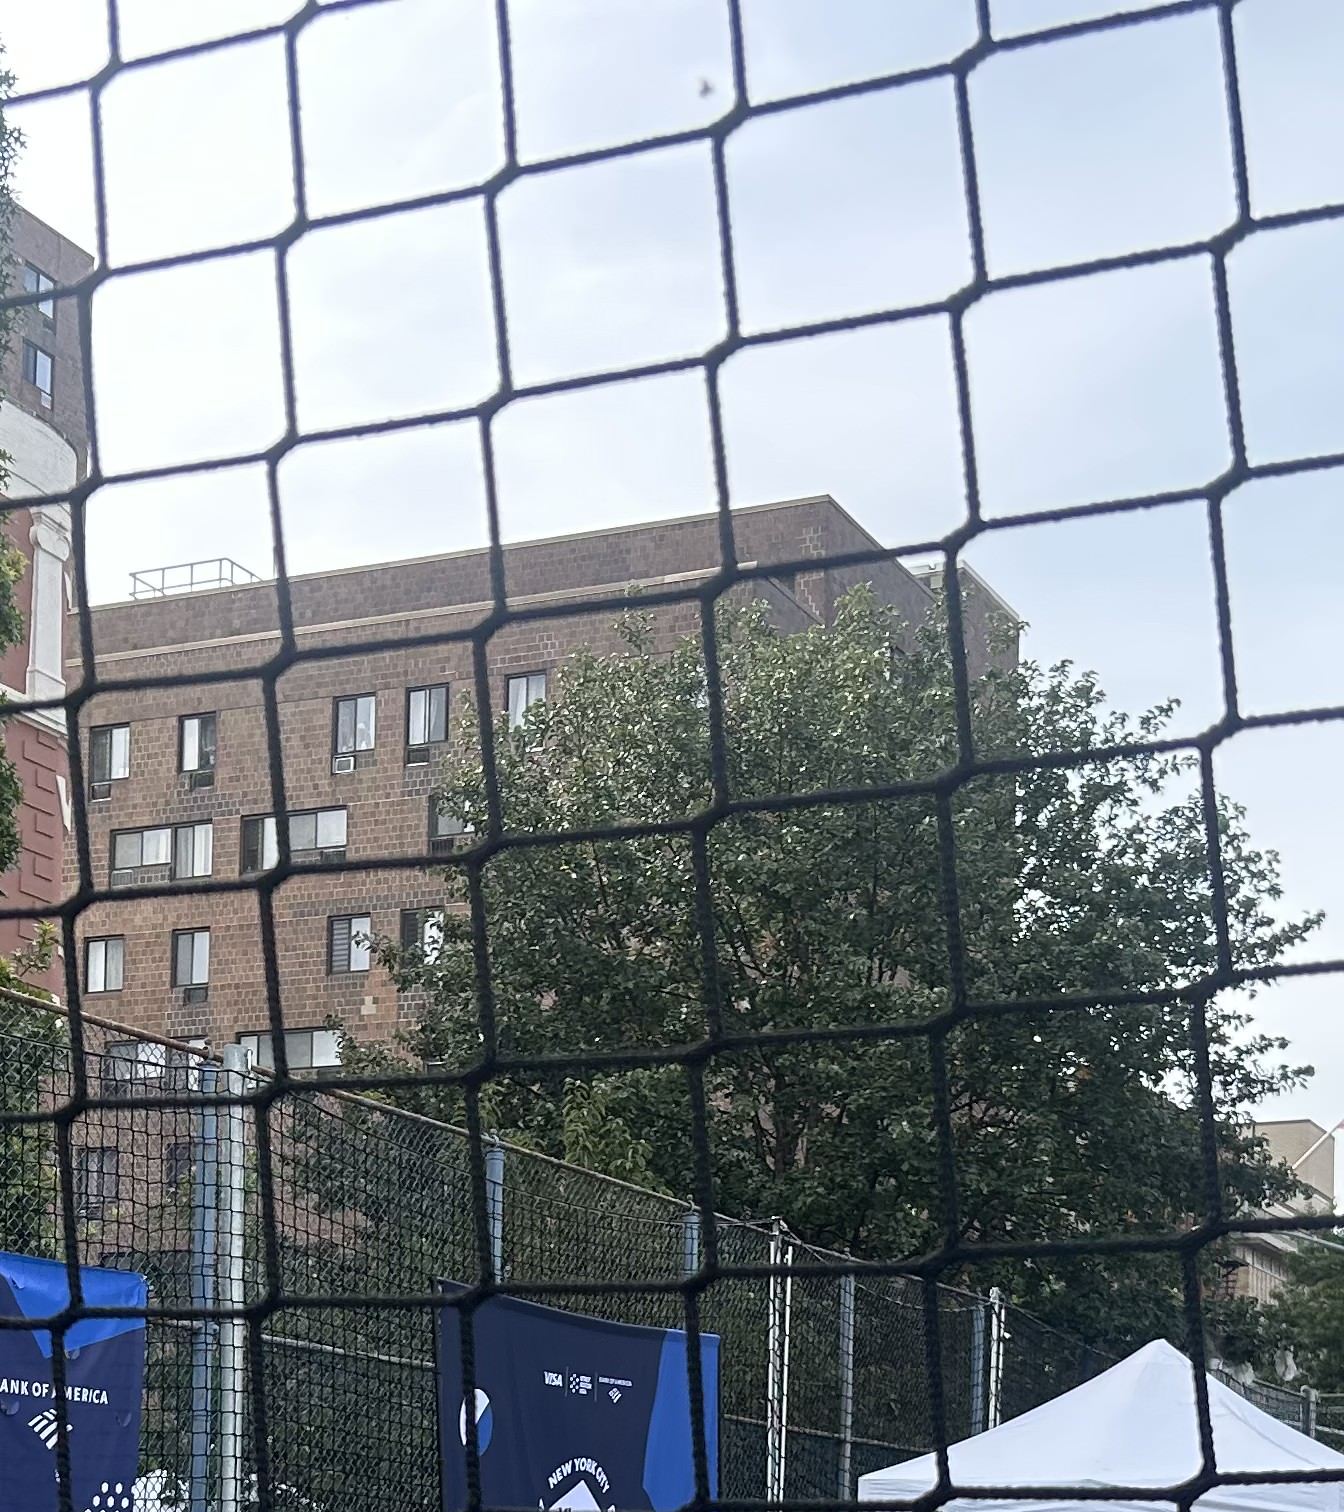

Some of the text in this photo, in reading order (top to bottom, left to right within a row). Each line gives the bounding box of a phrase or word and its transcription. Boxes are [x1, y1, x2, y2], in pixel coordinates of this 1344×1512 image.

[544, 1371, 562, 1387] VISA
[32, 1382, 49, 1398] OF
[52, 1385, 108, 1405] MERICA
[548, 1457, 610, 1494] NEW YORK CITY
